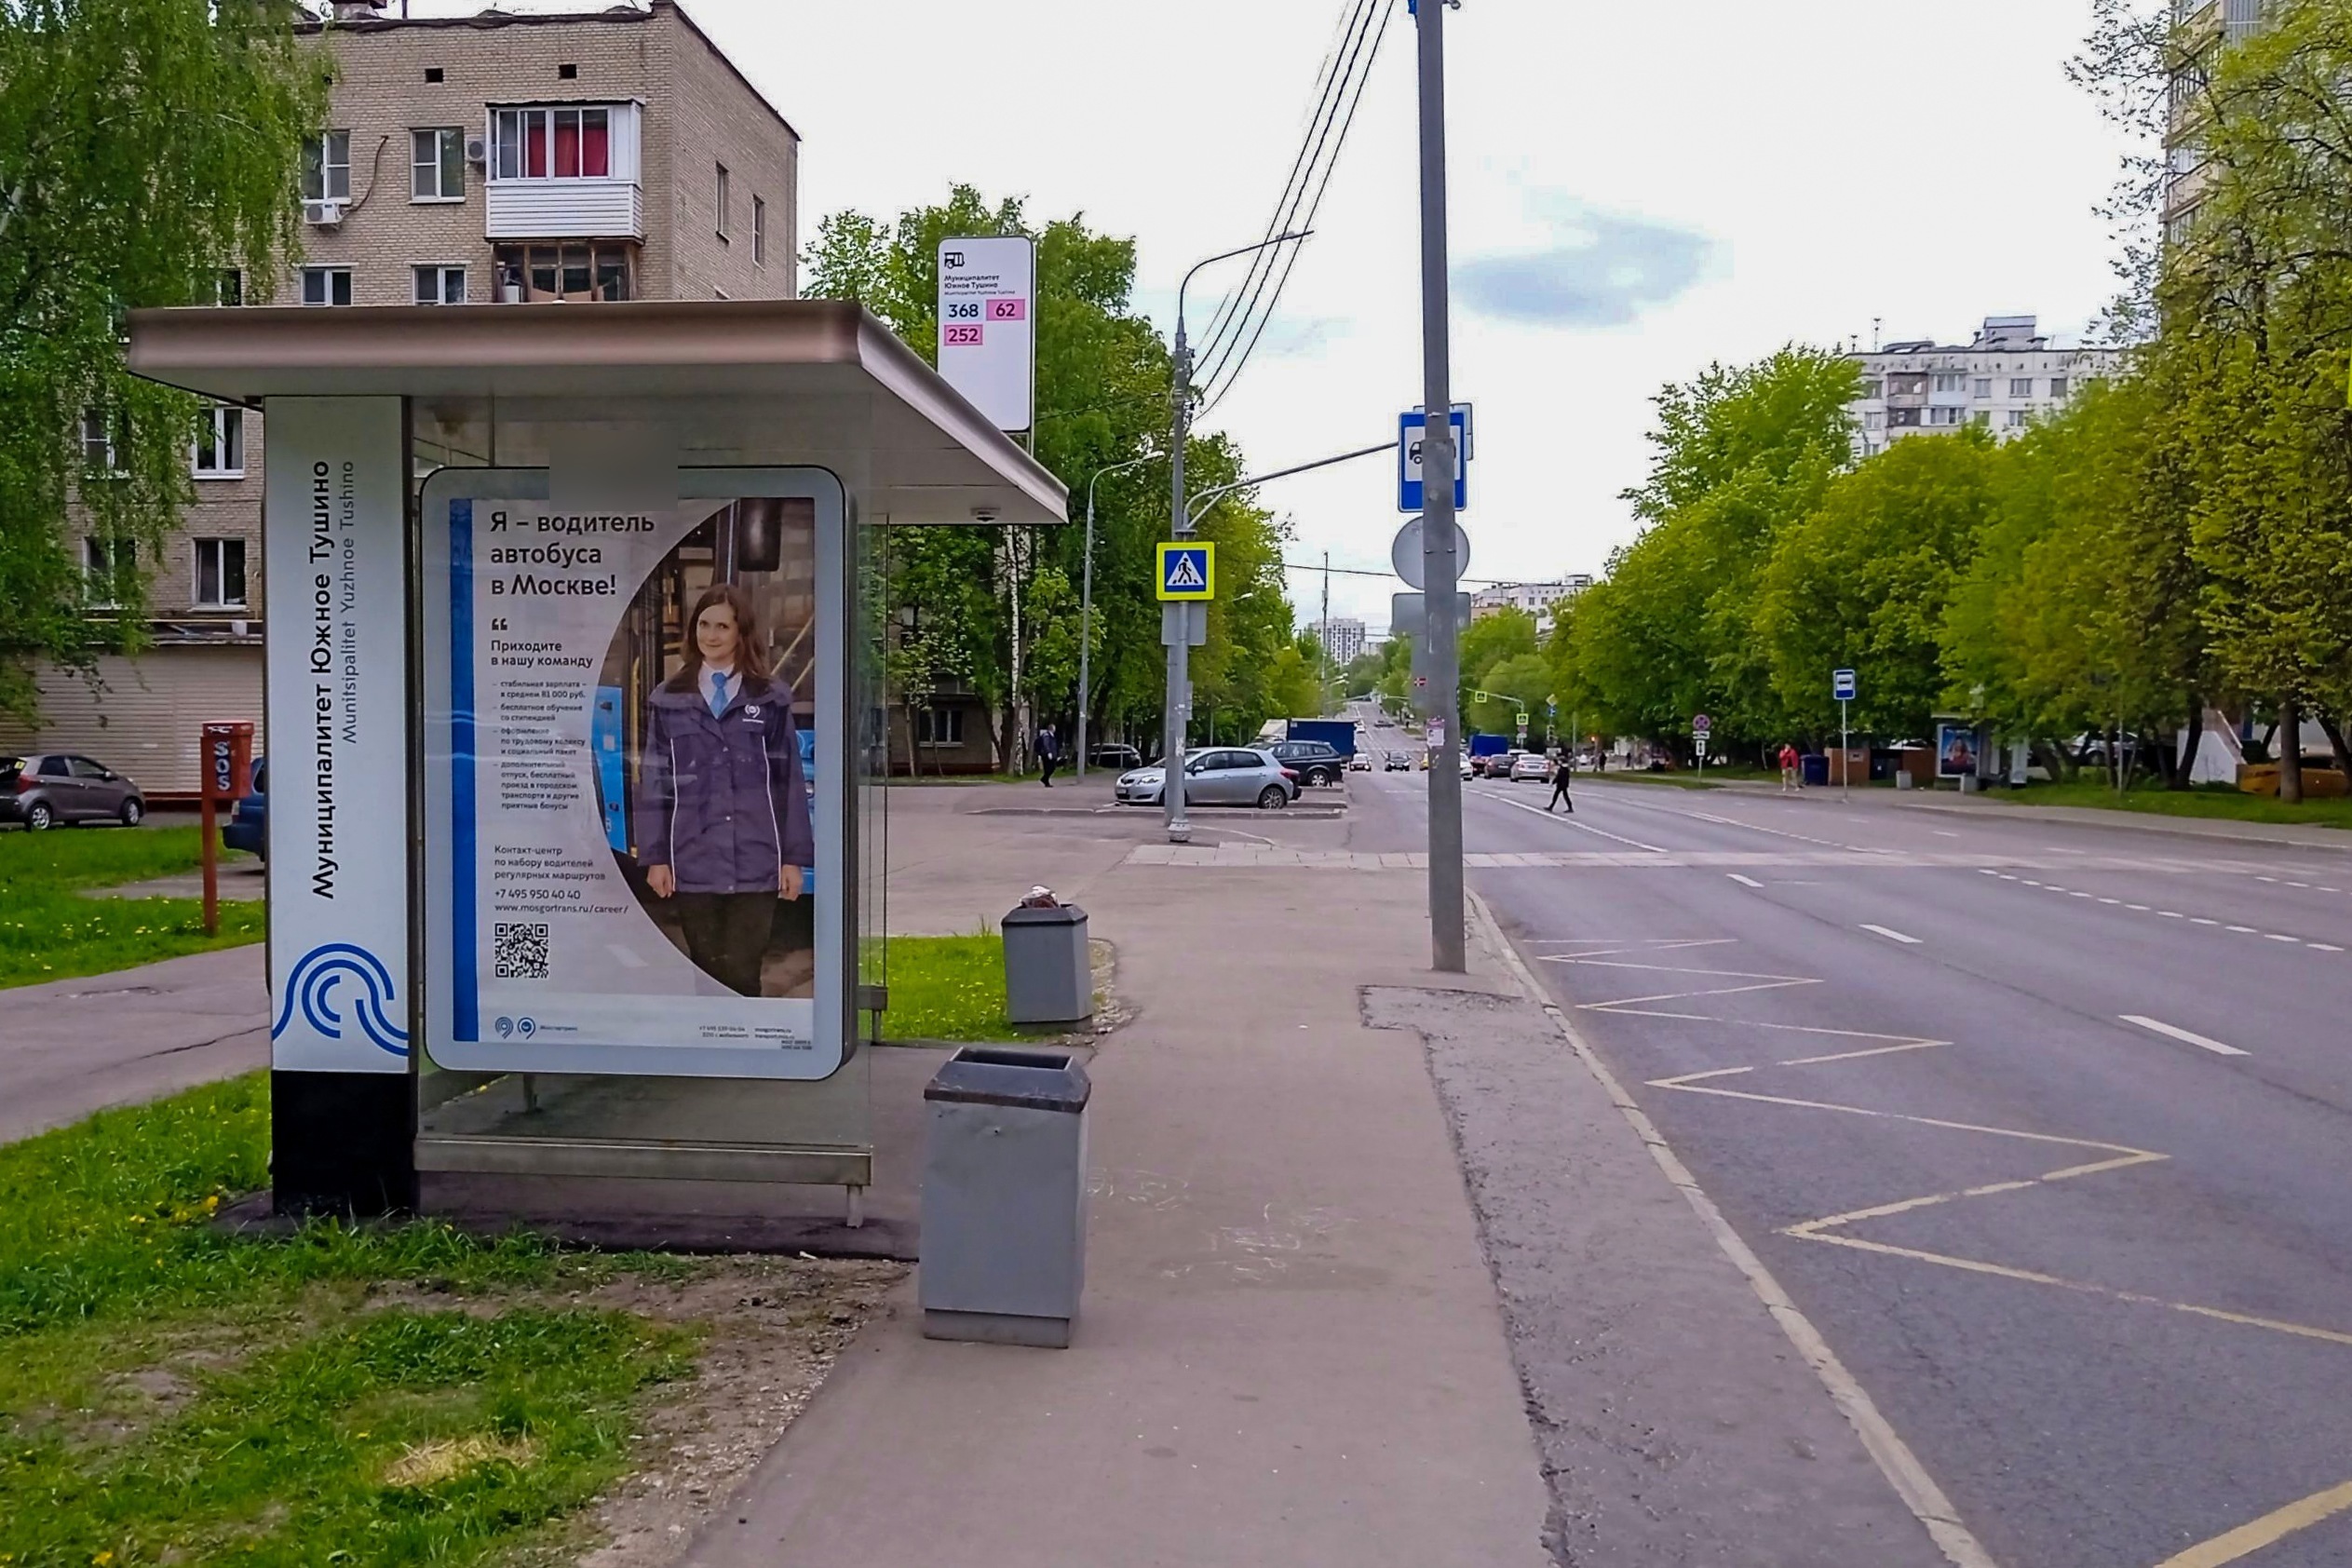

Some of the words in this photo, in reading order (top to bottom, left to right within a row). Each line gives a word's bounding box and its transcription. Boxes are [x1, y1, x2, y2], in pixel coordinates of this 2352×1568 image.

[948, 304, 979, 318] 368
[996, 303, 1015, 317] 62
[948, 328, 979, 342] 252
[339, 461, 354, 531] Tushino
[309, 460, 335, 564] Тушино
[490, 512, 508, 532] Я
[538, 514, 655, 534] водитель
[491, 542, 602, 568] автобуса
[339, 538, 357, 615] Yuzhnoe
[492, 579, 505, 595] в
[511, 574, 616, 596] Москве!
[311, 574, 332, 674] Южное
[491, 641, 562, 652] Приходите
[492, 658, 498, 666] в
[502, 658, 534, 669] нашу
[537, 657, 593, 669] команду
[340, 622, 359, 744] Munitsipalitet
[569, 691, 586, 699] руб.
[547, 704, 582, 712] обучение
[214, 741, 231, 791] SOS
[311, 683, 340, 899] Муниципалитет
[540, 802, 568, 811] бонусы
[494, 845, 562, 856] Контакт-центр
[508, 858, 542, 868] набору
[544, 859, 594, 868] водителей
[494, 872, 550, 880] регулярных
[552, 872, 606, 881] маршрутов
[495, 889, 506, 899] +7
[508, 889, 527, 899] 495
[530, 890, 549, 899] 950
[551, 890, 565, 899] 40
[568, 890, 581, 899] 40
[494, 904, 629, 914] www.mosgortrans.ru/career/
